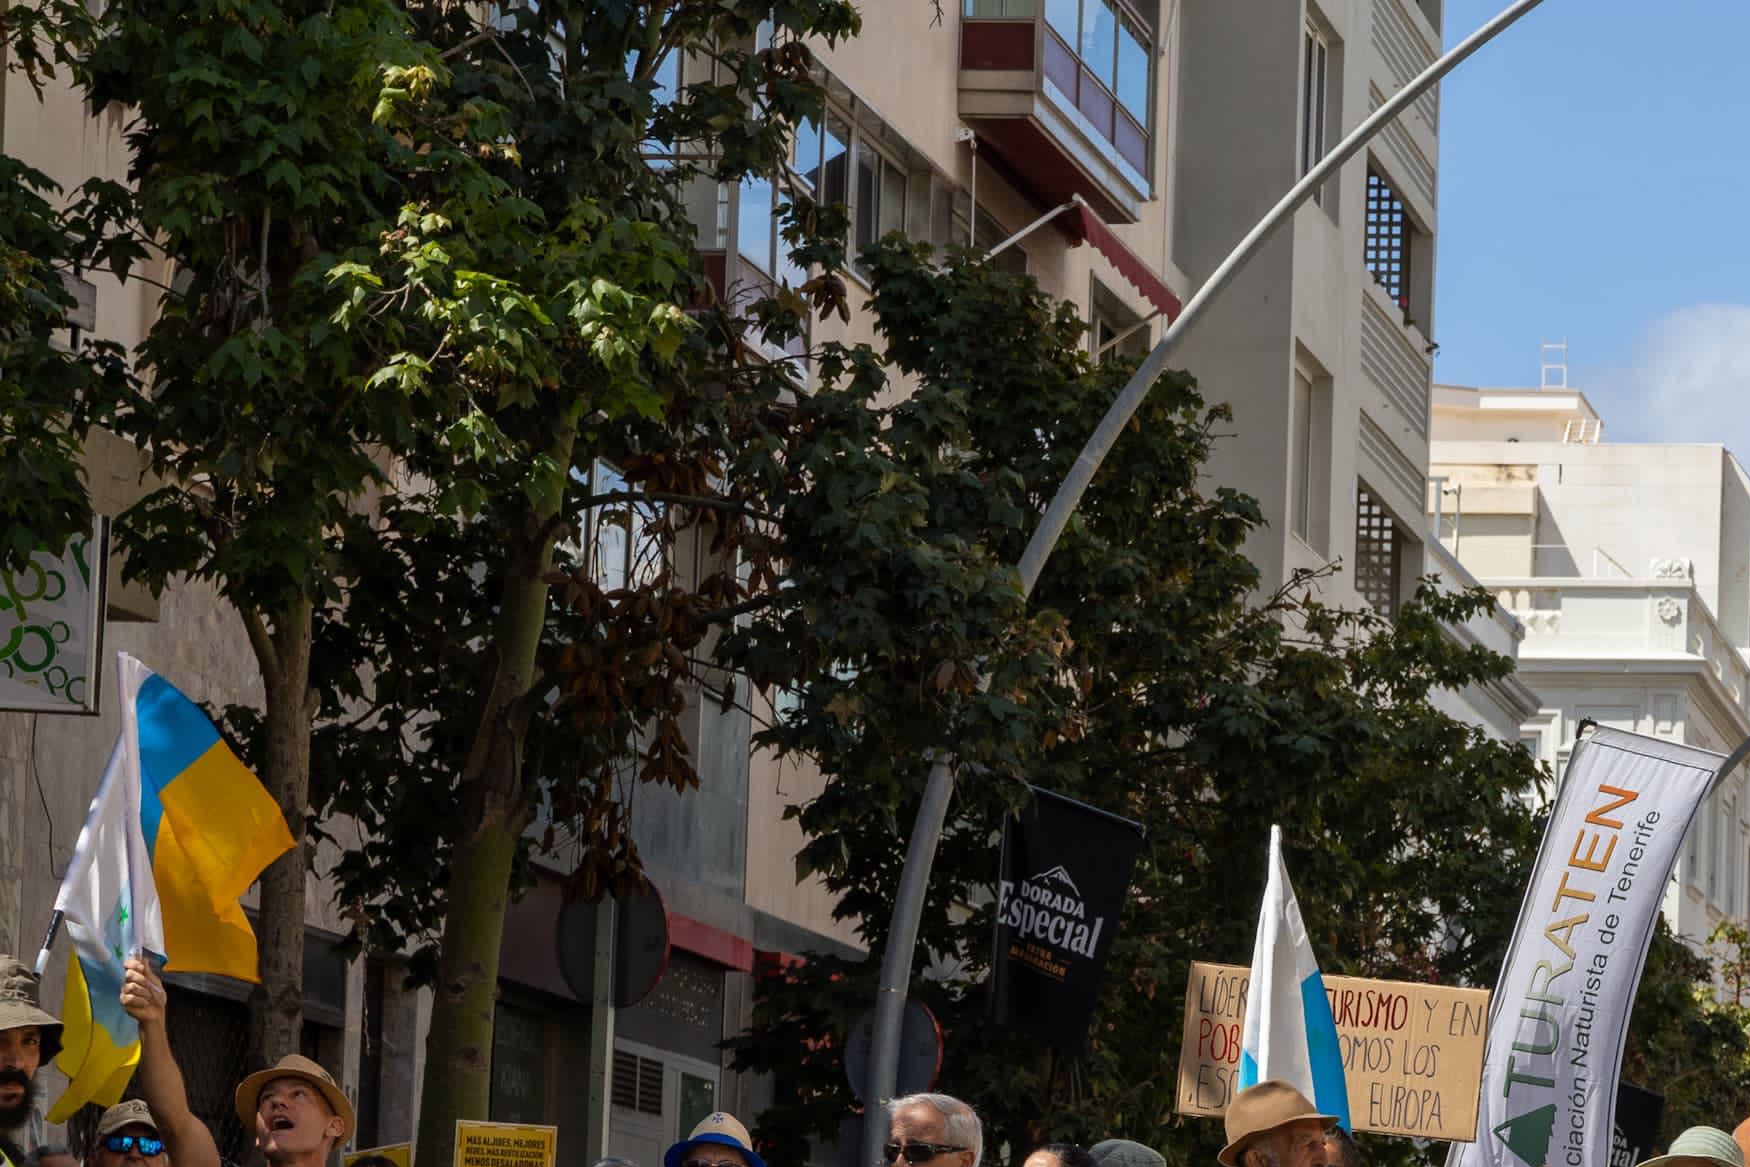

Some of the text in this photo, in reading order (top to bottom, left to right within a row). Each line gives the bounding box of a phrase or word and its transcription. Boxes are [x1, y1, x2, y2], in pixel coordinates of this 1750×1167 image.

[1608, 811, 1660, 903] Tenerife
[998, 879, 1104, 959] Especial
[1021, 880, 1085, 919] DORADA
[1598, 914, 1620, 945] de
[1423, 999, 1441, 1034] Y
[1448, 1000, 1484, 1037] EN
[1570, 953, 1608, 1068] Naturista
[1198, 1018, 1241, 1064] POB
[1402, 1042, 1441, 1078] LOS
[1369, 1081, 1443, 1131] EUROPA
[464, 1156, 490, 1167] MENOS
